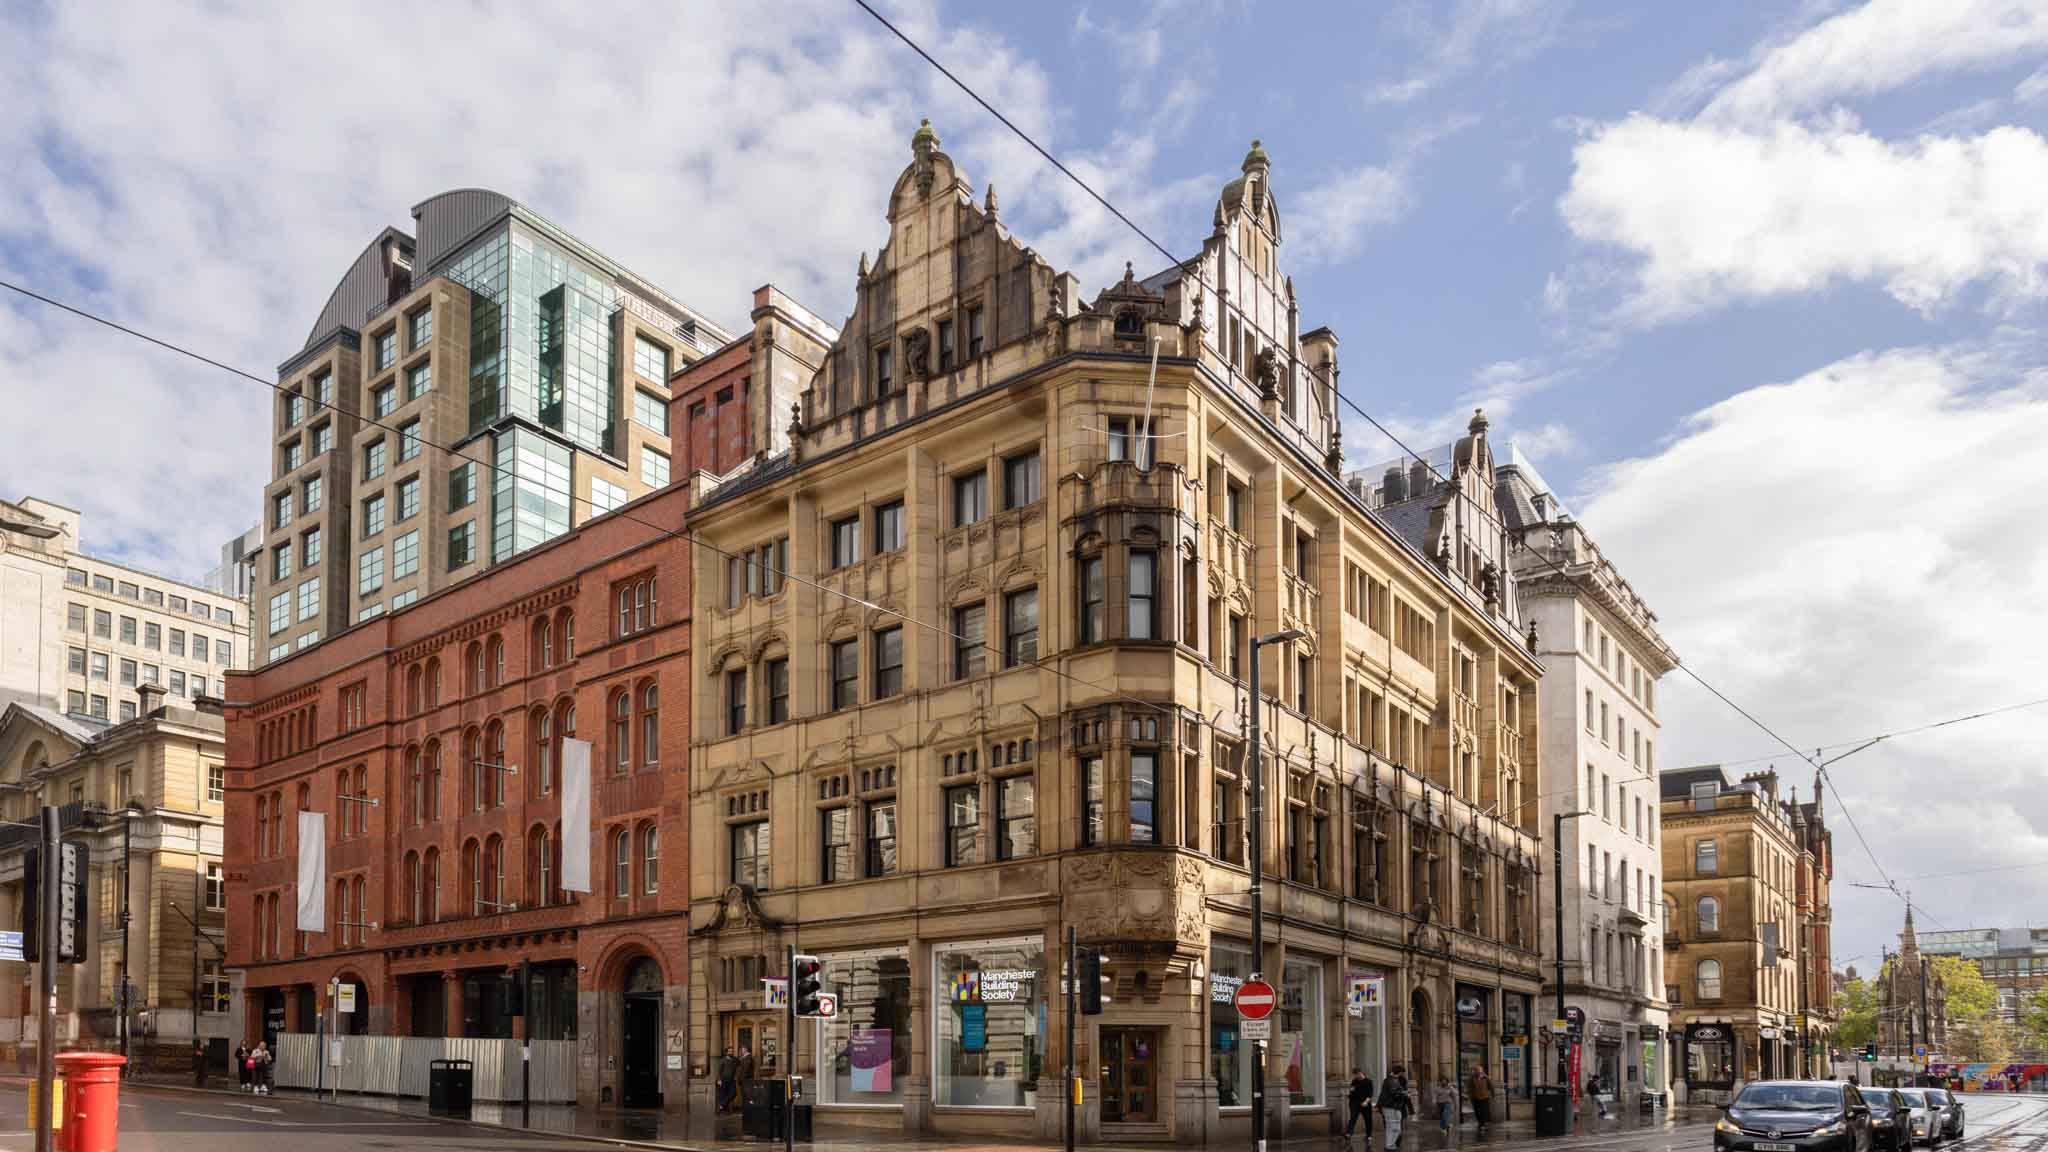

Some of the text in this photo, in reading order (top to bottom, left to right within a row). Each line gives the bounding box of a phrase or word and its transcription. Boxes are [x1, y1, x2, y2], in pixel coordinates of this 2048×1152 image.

[981, 970, 1036, 981] Manchester
[981, 981, 1018, 991] Building
[1211, 983, 1234, 996] Building
[981, 991, 1016, 1000] Society
[1212, 992, 1232, 1005] Society
